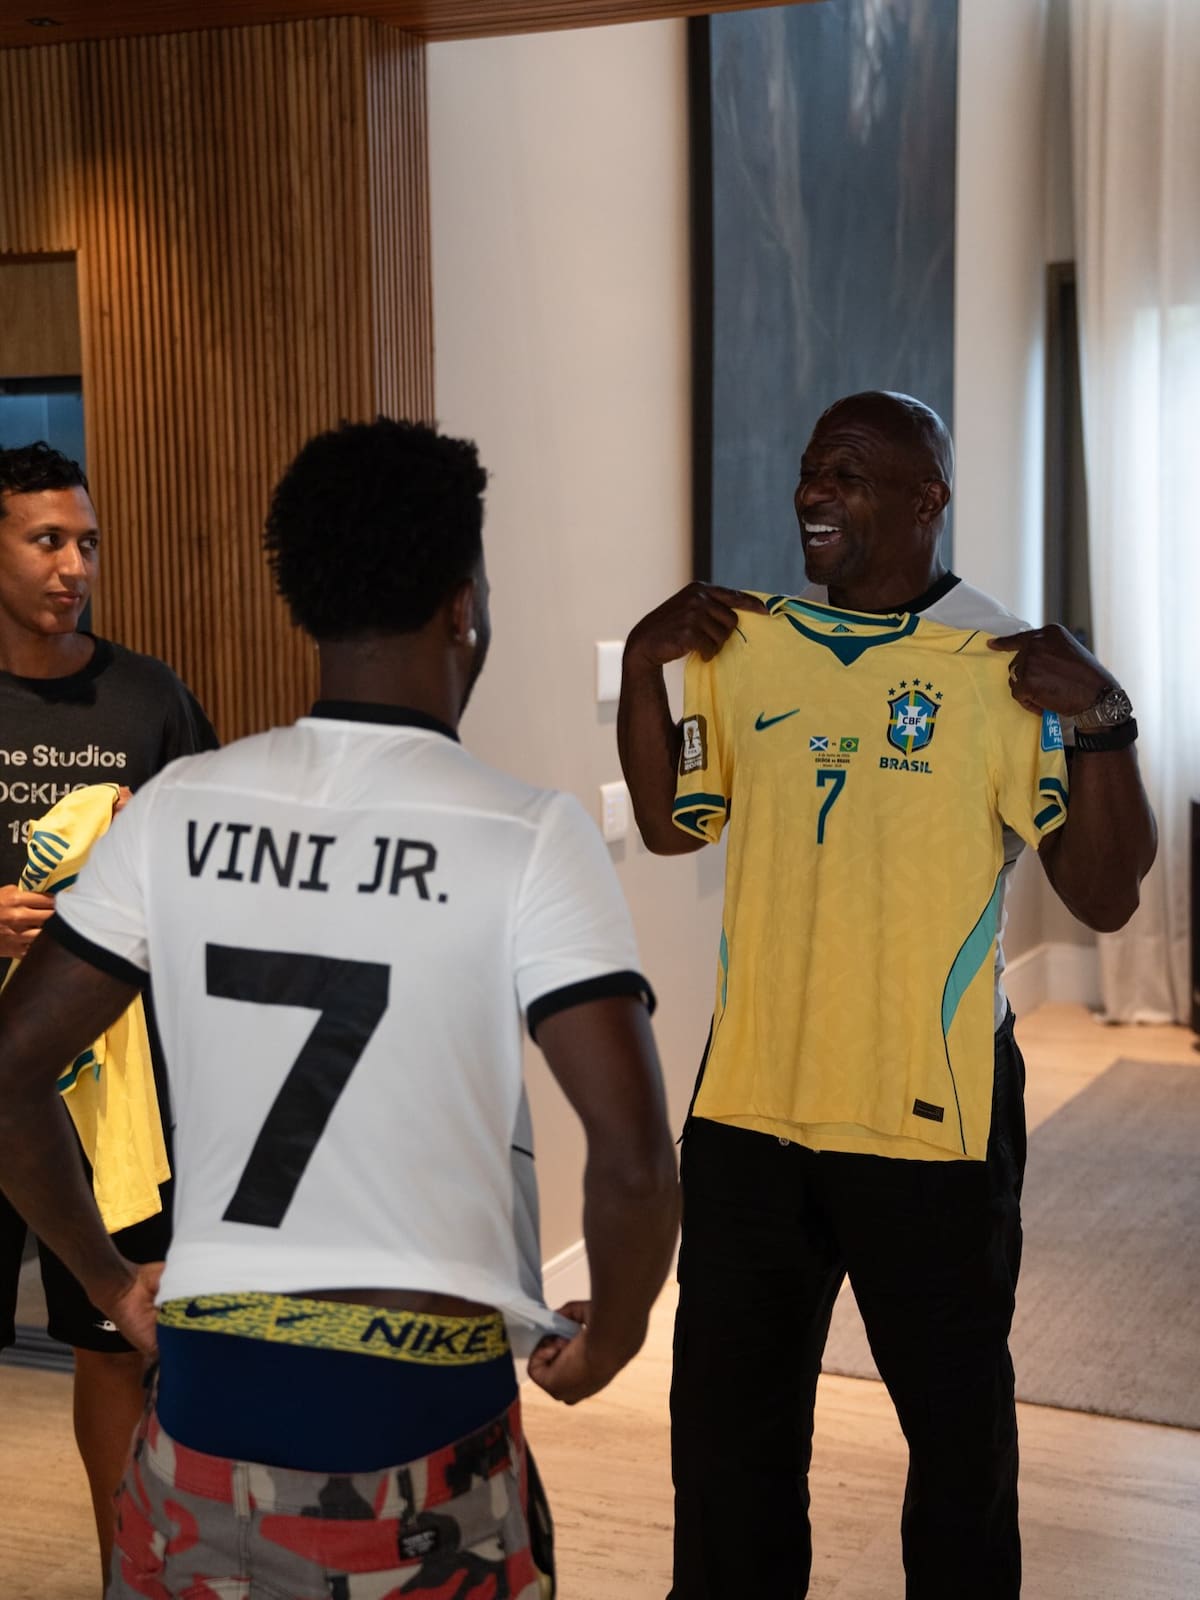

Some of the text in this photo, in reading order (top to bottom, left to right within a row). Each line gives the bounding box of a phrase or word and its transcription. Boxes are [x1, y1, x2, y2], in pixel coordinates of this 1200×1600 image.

[902, 716, 921, 725] CBF
[32, 744, 127, 768] Studios
[879, 756, 933, 774] BRASIL
[815, 769, 847, 844] 7
[187, 819, 448, 903] VINI JR.
[206, 942, 391, 1229] 7
[360, 1315, 496, 1356] NIKE
